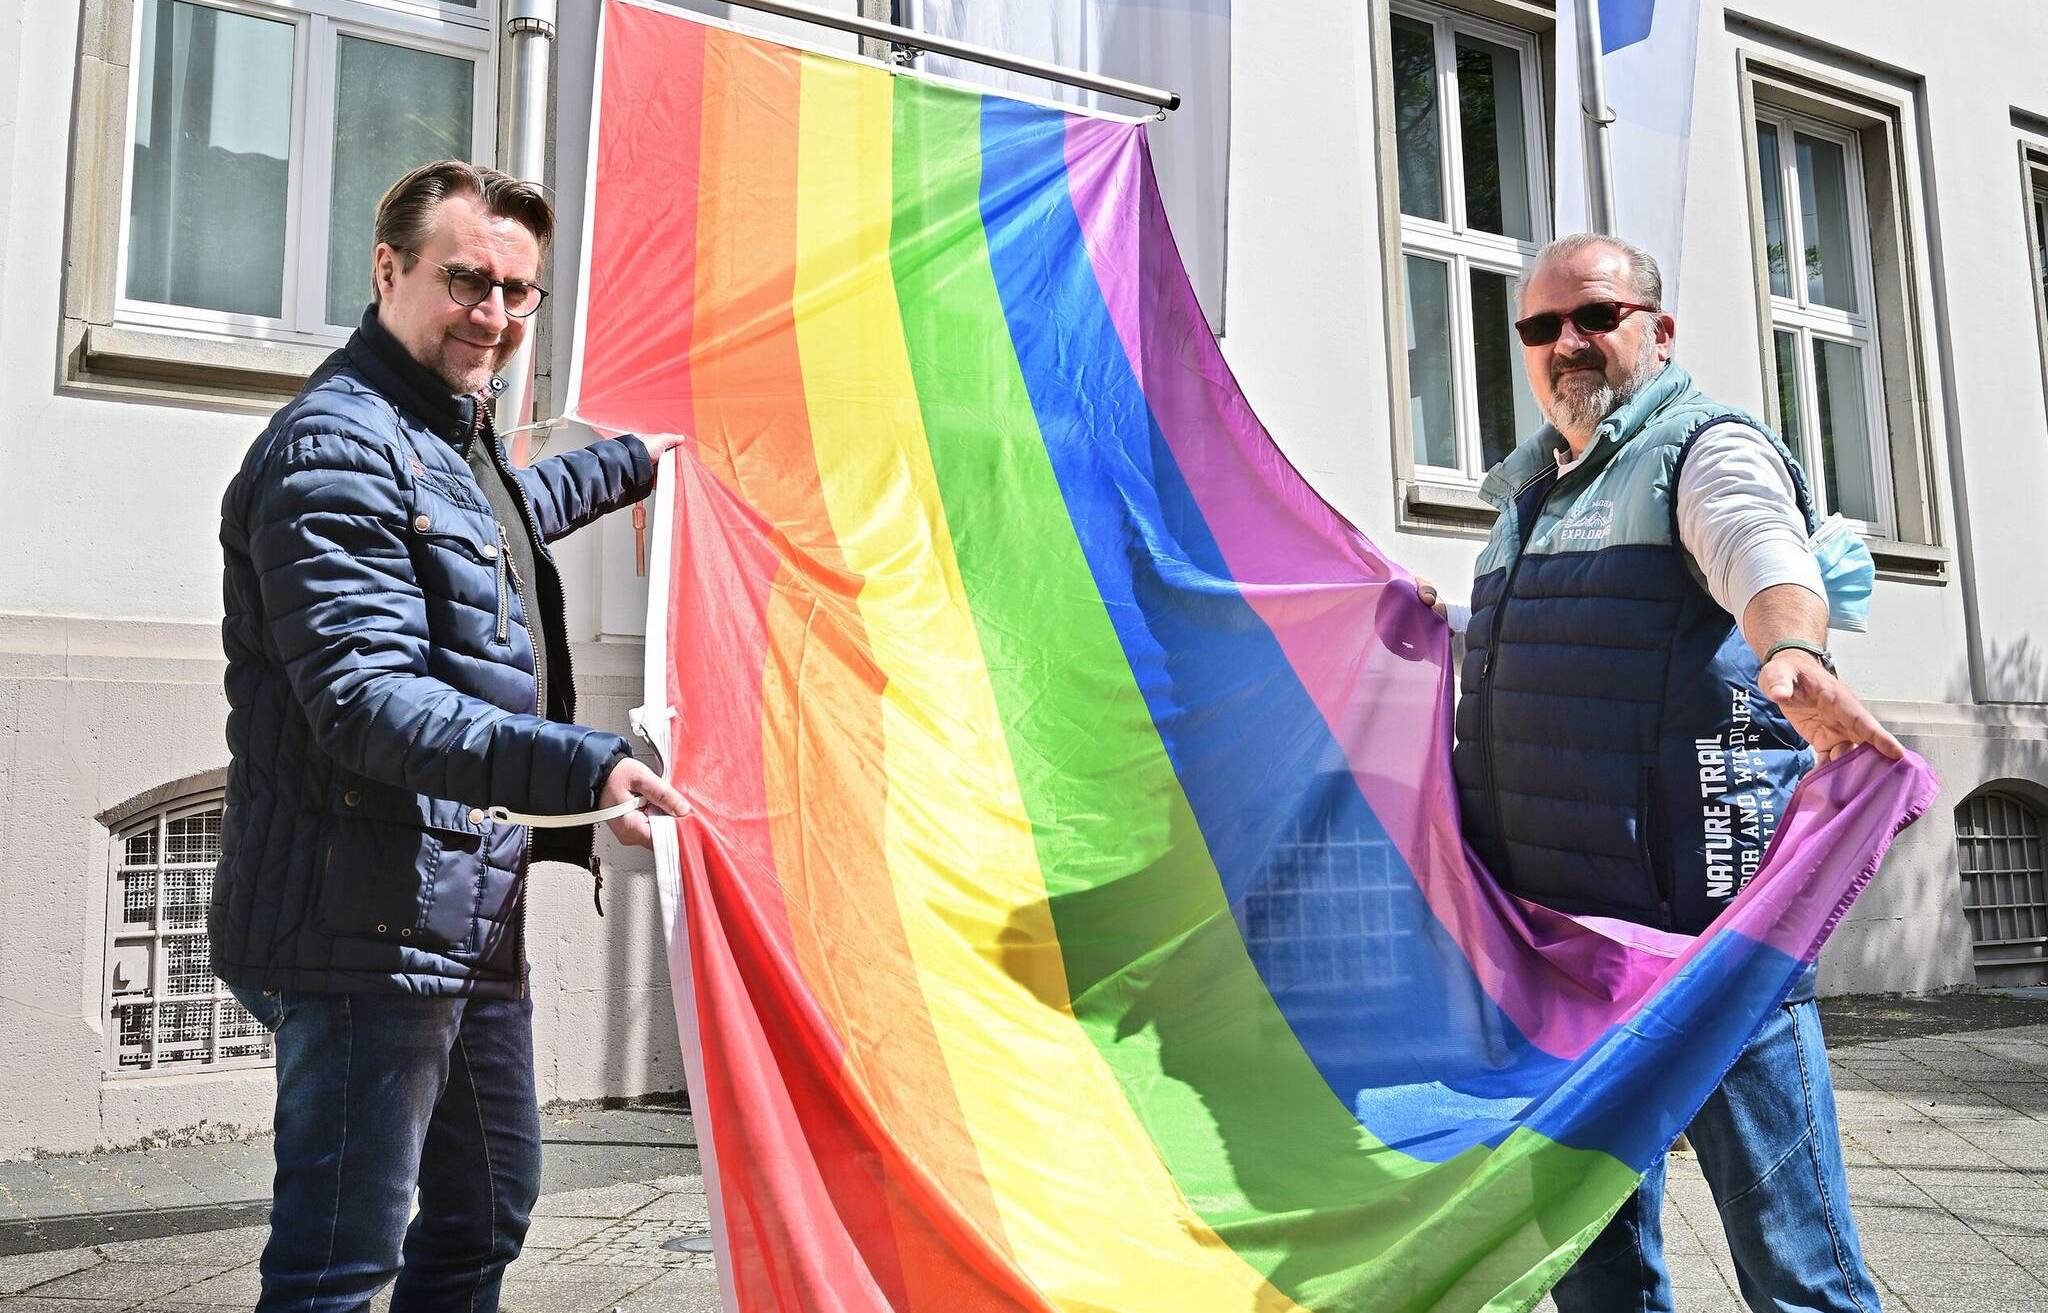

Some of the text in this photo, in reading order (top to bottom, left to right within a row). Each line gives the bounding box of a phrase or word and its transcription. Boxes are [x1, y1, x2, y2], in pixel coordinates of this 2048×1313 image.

[1728, 688, 1752, 785] WILDLIFE
[1695, 733, 1734, 898] NATURE TRAIL
[1736, 794, 1760, 839] AND
